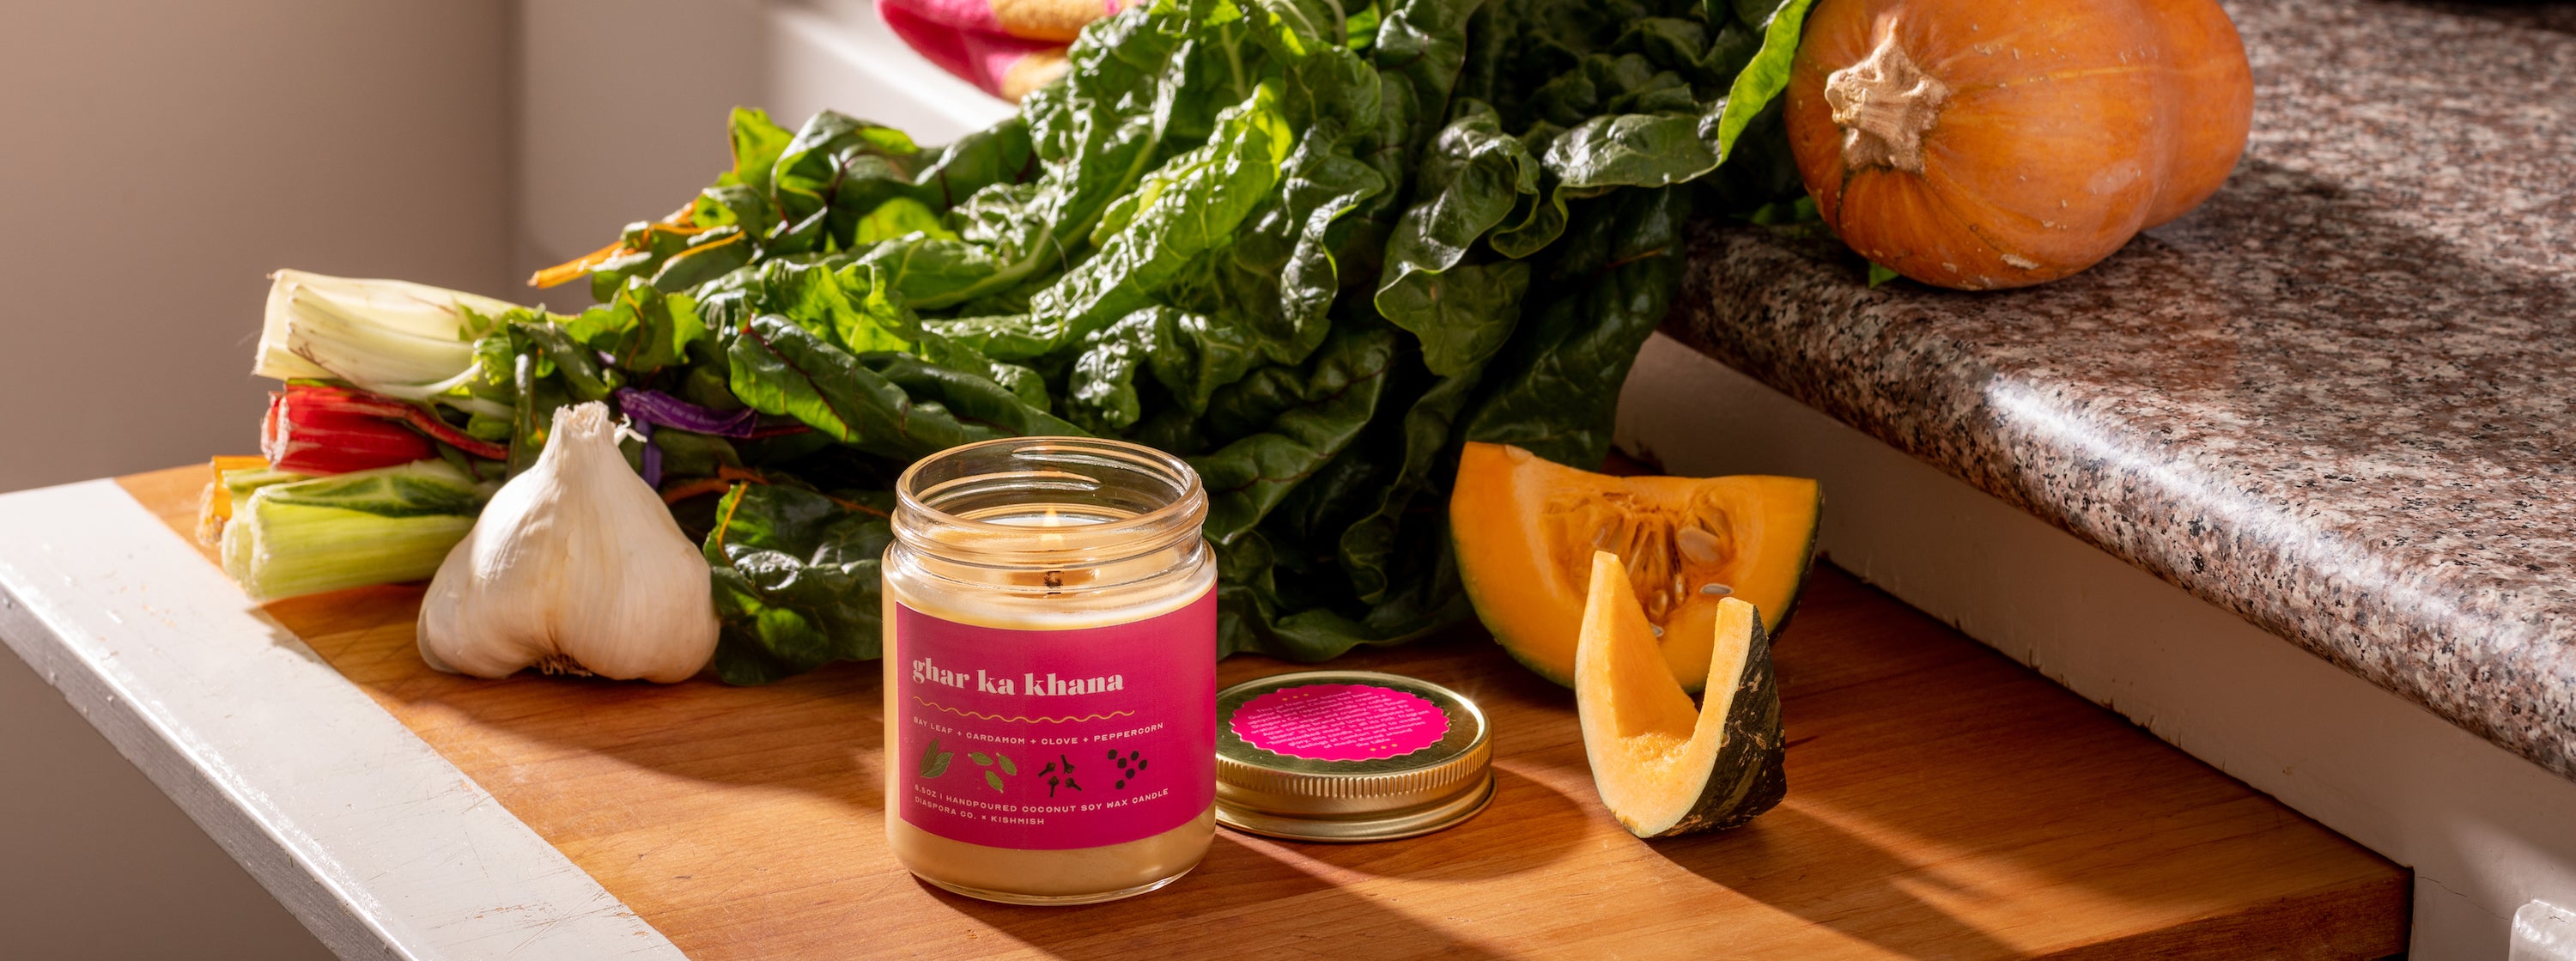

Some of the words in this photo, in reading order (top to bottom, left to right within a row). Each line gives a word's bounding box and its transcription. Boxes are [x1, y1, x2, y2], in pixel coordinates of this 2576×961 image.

[913, 657, 970, 689] ghar
[977, 669, 1016, 696] ka
[1024, 673, 1125, 696] khana
[914, 716, 928, 727] BAY
[930, 722, 954, 735] LEAF
[966, 732, 1026, 745] CARDAMOM
[1041, 737, 1078, 745] CLOVE
[1093, 722, 1164, 743] PEPPERCORN
[914, 795, 957, 816] DIASPORA
[960, 810, 978, 820] CO.
[990, 815, 1045, 825] KISHMISH
[945, 795, 1018, 812] HANDPOURED
[1022, 805, 1077, 813] COCONUT
[1080, 803, 1103, 812] SOY
[1106, 799, 1128, 809] WAX
[1132, 788, 1170, 805] CANDLE
